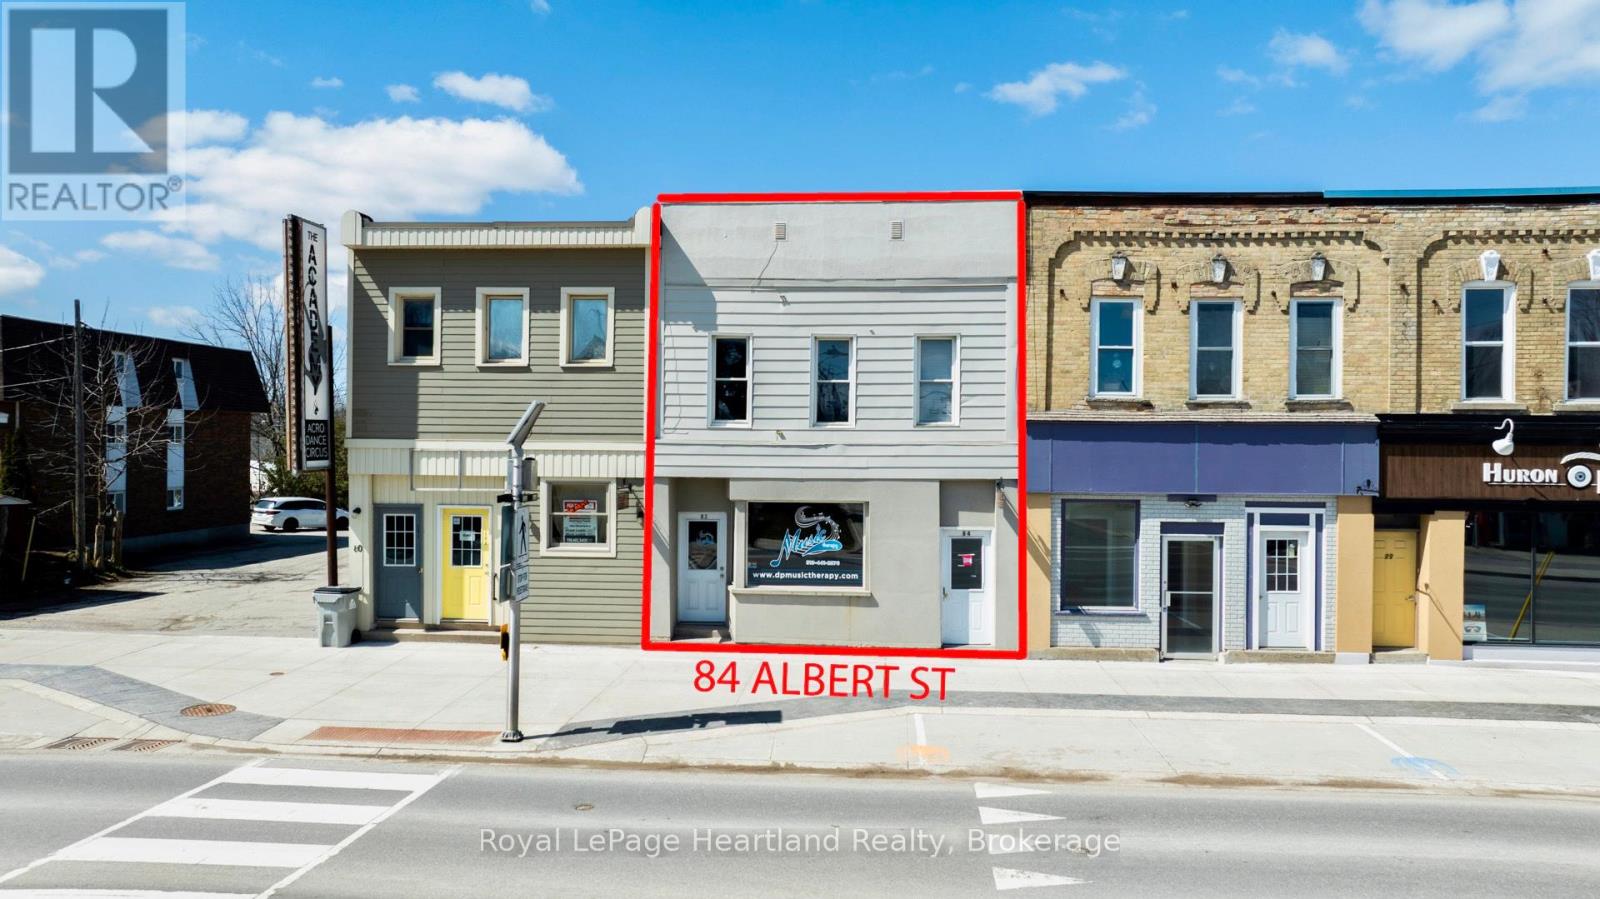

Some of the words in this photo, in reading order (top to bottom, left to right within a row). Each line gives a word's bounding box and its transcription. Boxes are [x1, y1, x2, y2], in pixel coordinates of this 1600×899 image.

[307, 231, 319, 242] THE
[308, 244, 322, 396] ACADEMY
[307, 423, 325, 433] ACRO
[305, 435, 327, 445] DANCE
[306, 447, 328, 457] CIRCUS
[1482, 463, 1558, 483] HURON
[752, 572, 859, 580] www.dpmusictherapy.com
